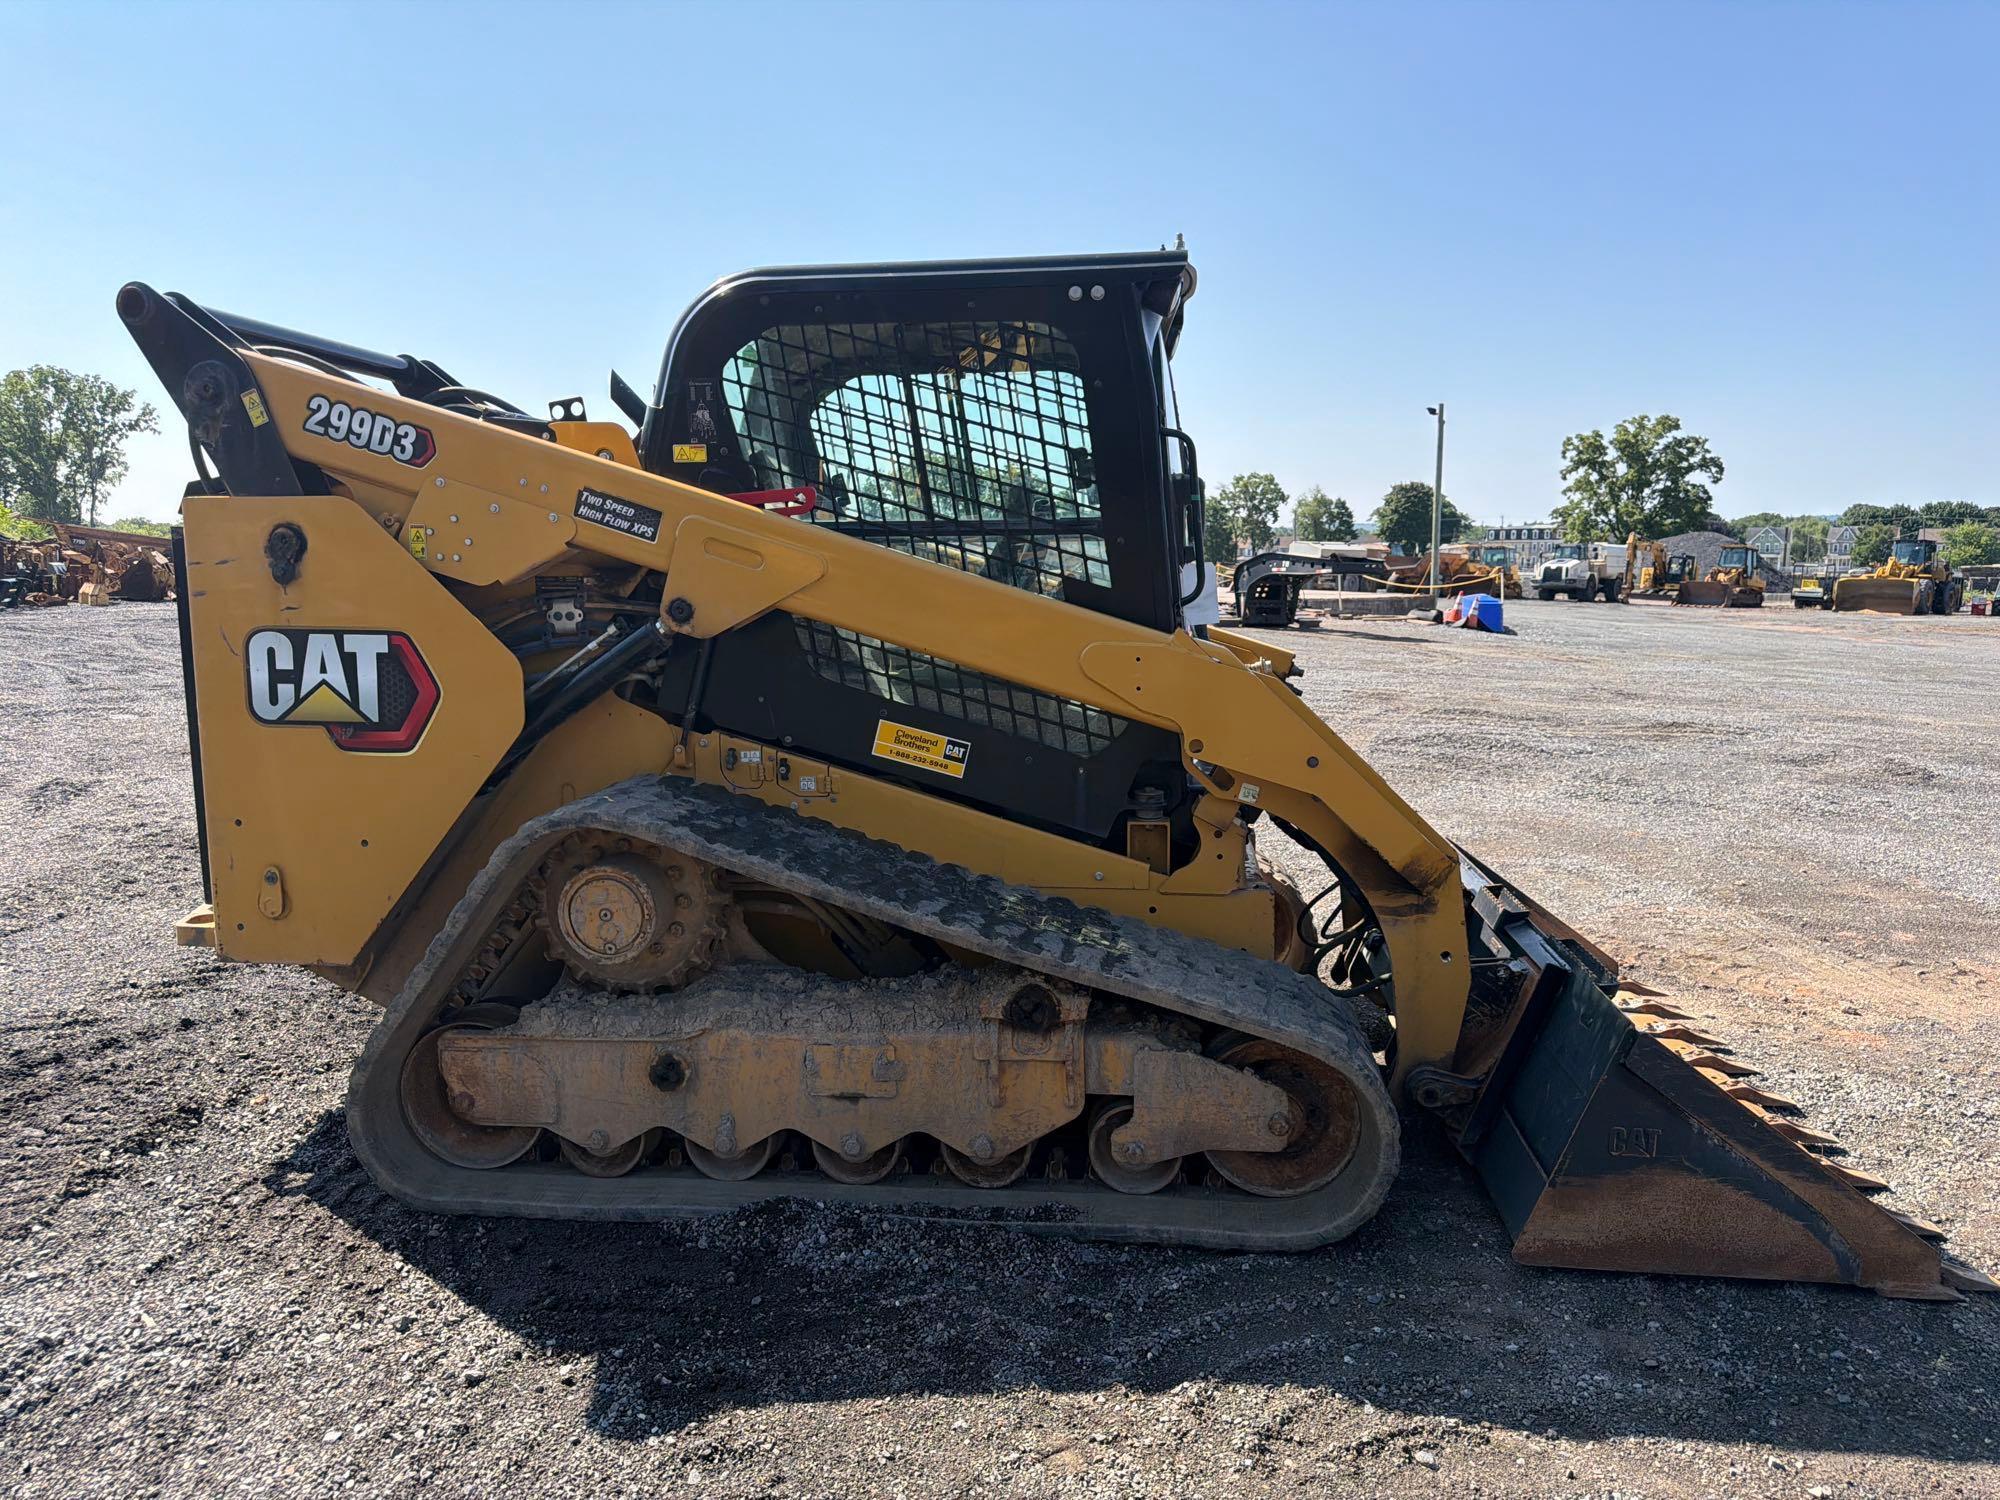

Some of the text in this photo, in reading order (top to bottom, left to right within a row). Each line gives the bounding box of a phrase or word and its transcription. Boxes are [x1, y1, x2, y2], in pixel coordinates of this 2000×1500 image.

[304, 396, 417, 461] 299D3
[631, 522, 655, 538] XPS
[248, 631, 389, 723] CAT
[893, 736, 931, 753] Brothers
[896, 729, 939, 747] Cleveland
[889, 749, 949, 770] 1-888-232-5948
[945, 744, 966, 758] CAT
[1608, 1126, 1663, 1158] CAT
